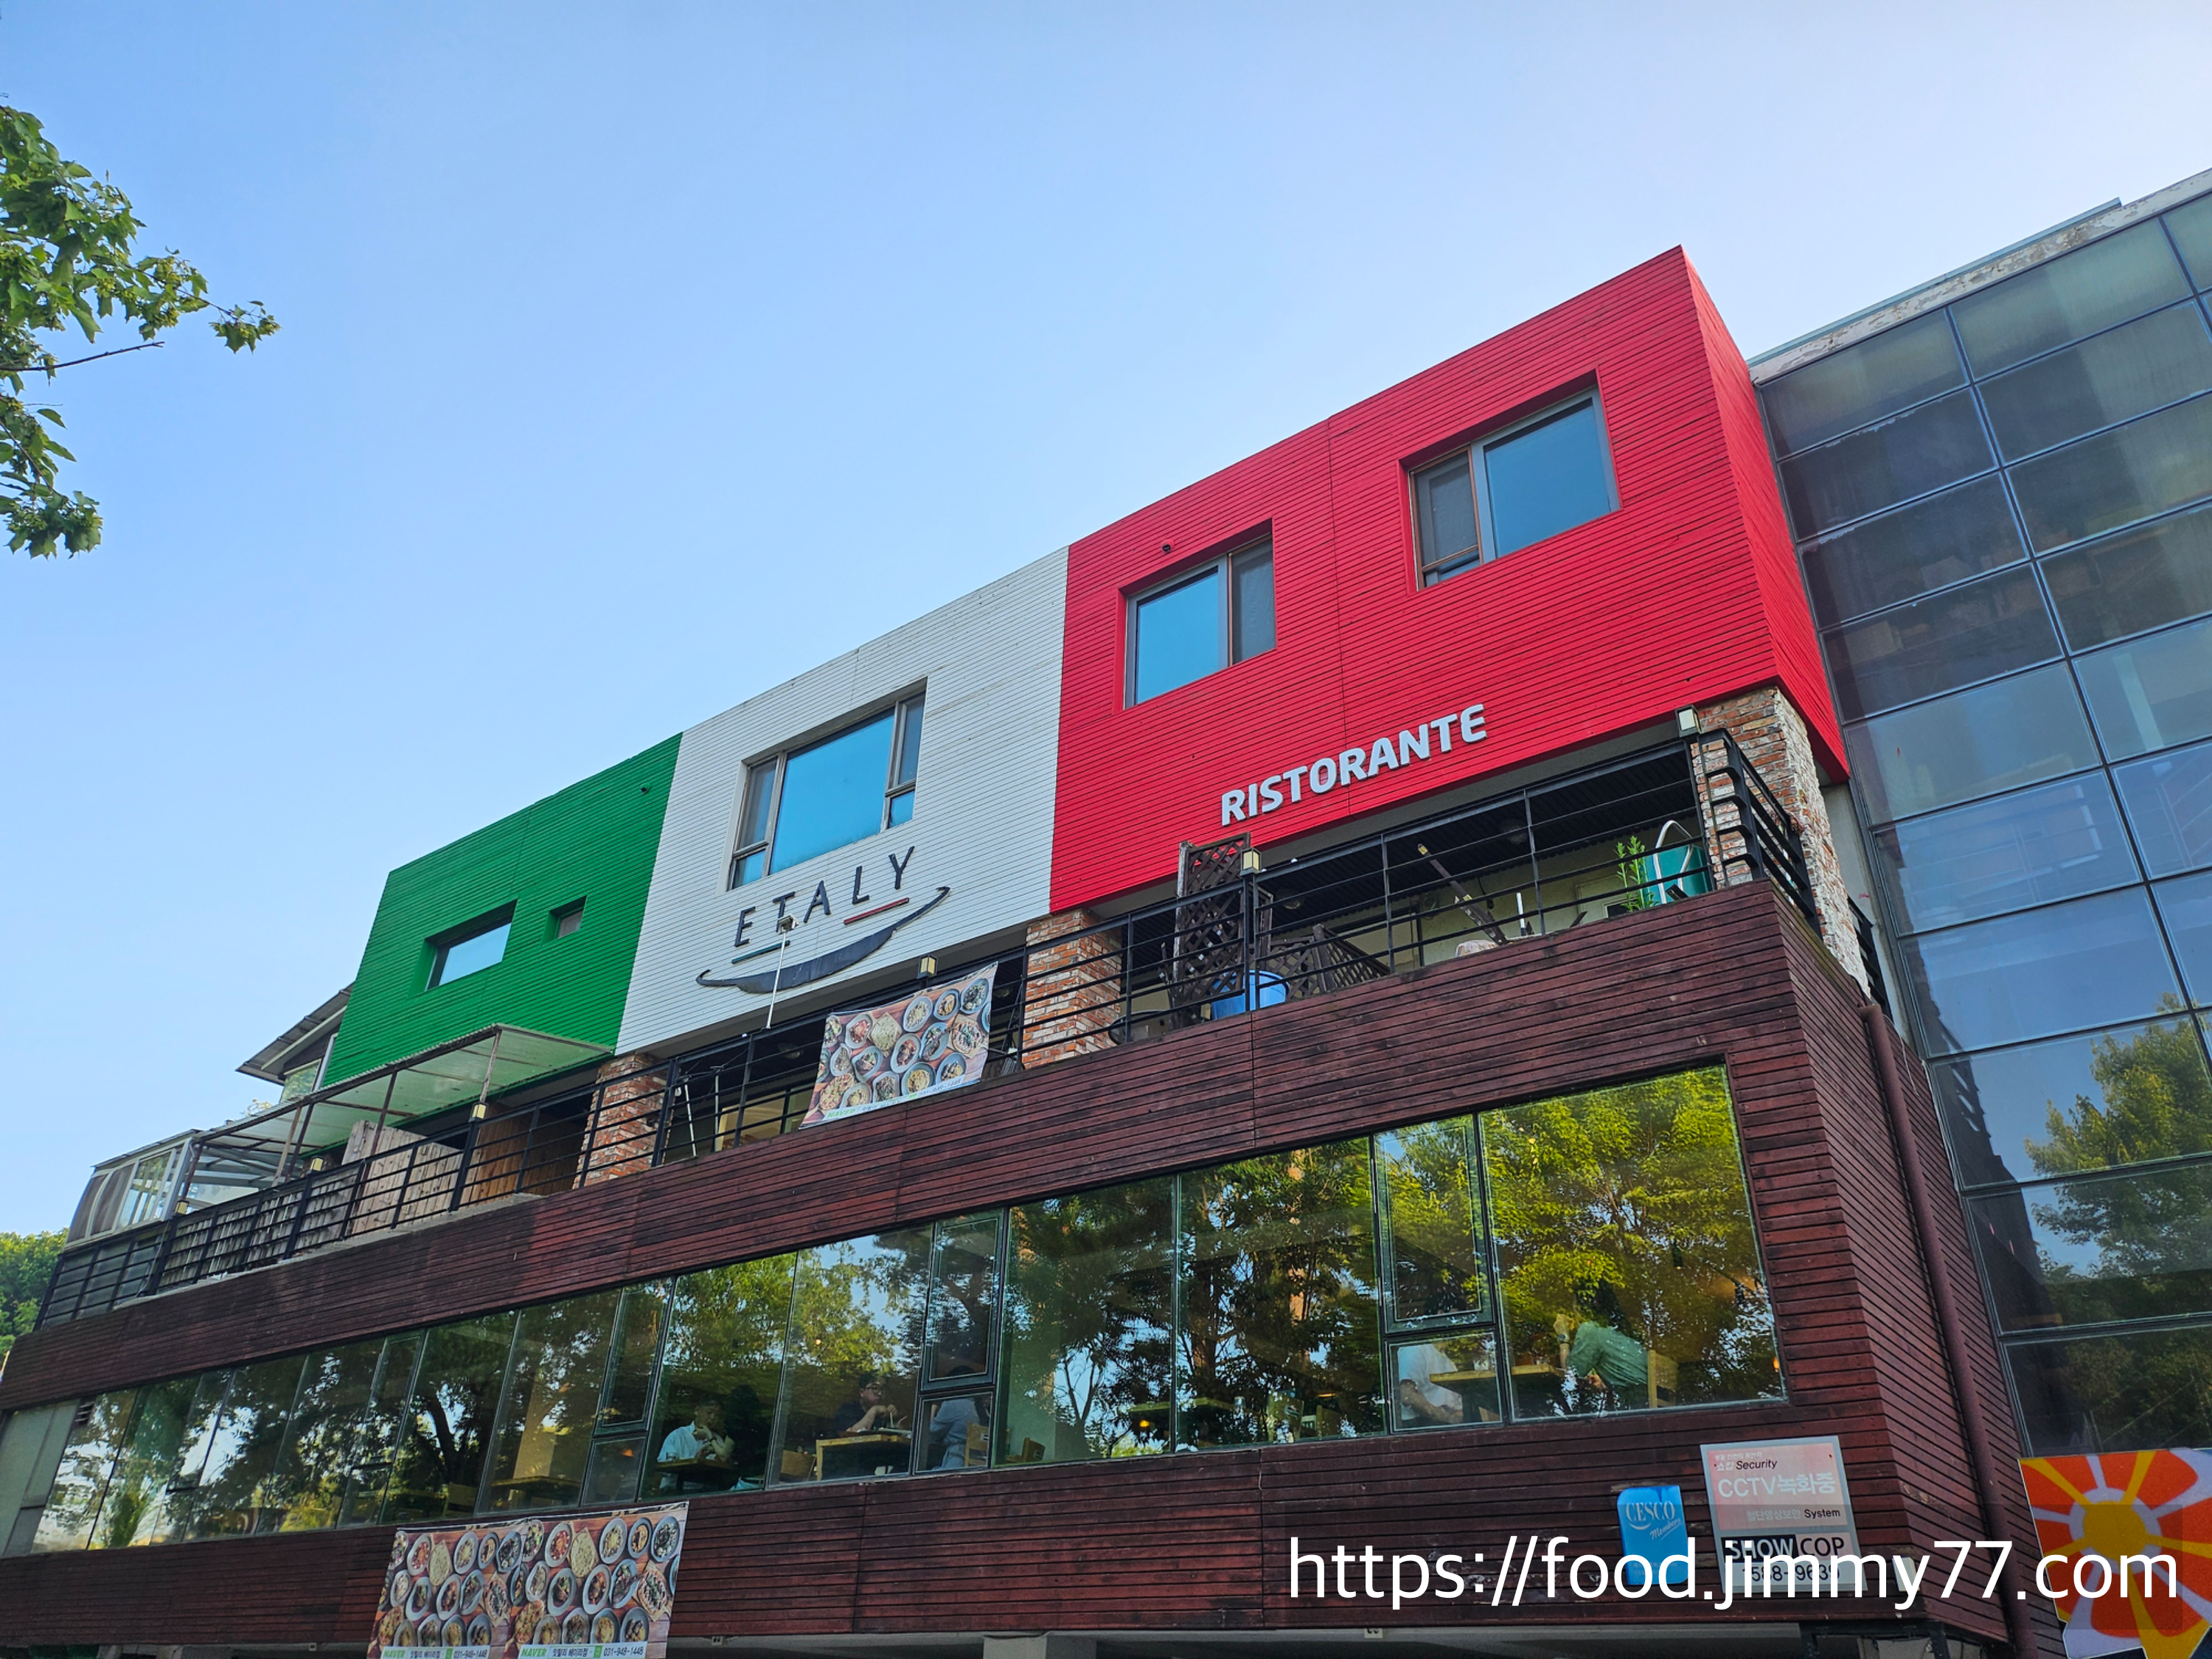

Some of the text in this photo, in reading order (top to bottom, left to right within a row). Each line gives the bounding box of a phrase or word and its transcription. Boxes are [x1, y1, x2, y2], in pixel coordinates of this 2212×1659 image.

[1221, 703, 1488, 827] RISTORANTE
[734, 846, 916, 947] ETALY
[1736, 1458, 1778, 1470] Security
[1717, 1472, 1836, 1498] CCTV녹화중
[1625, 1500, 1676, 1522] CESCO
[1804, 1508, 1841, 1520] System
[382, 1650, 405, 1658] NAVER
[521, 1648, 547, 1658] NAVER
